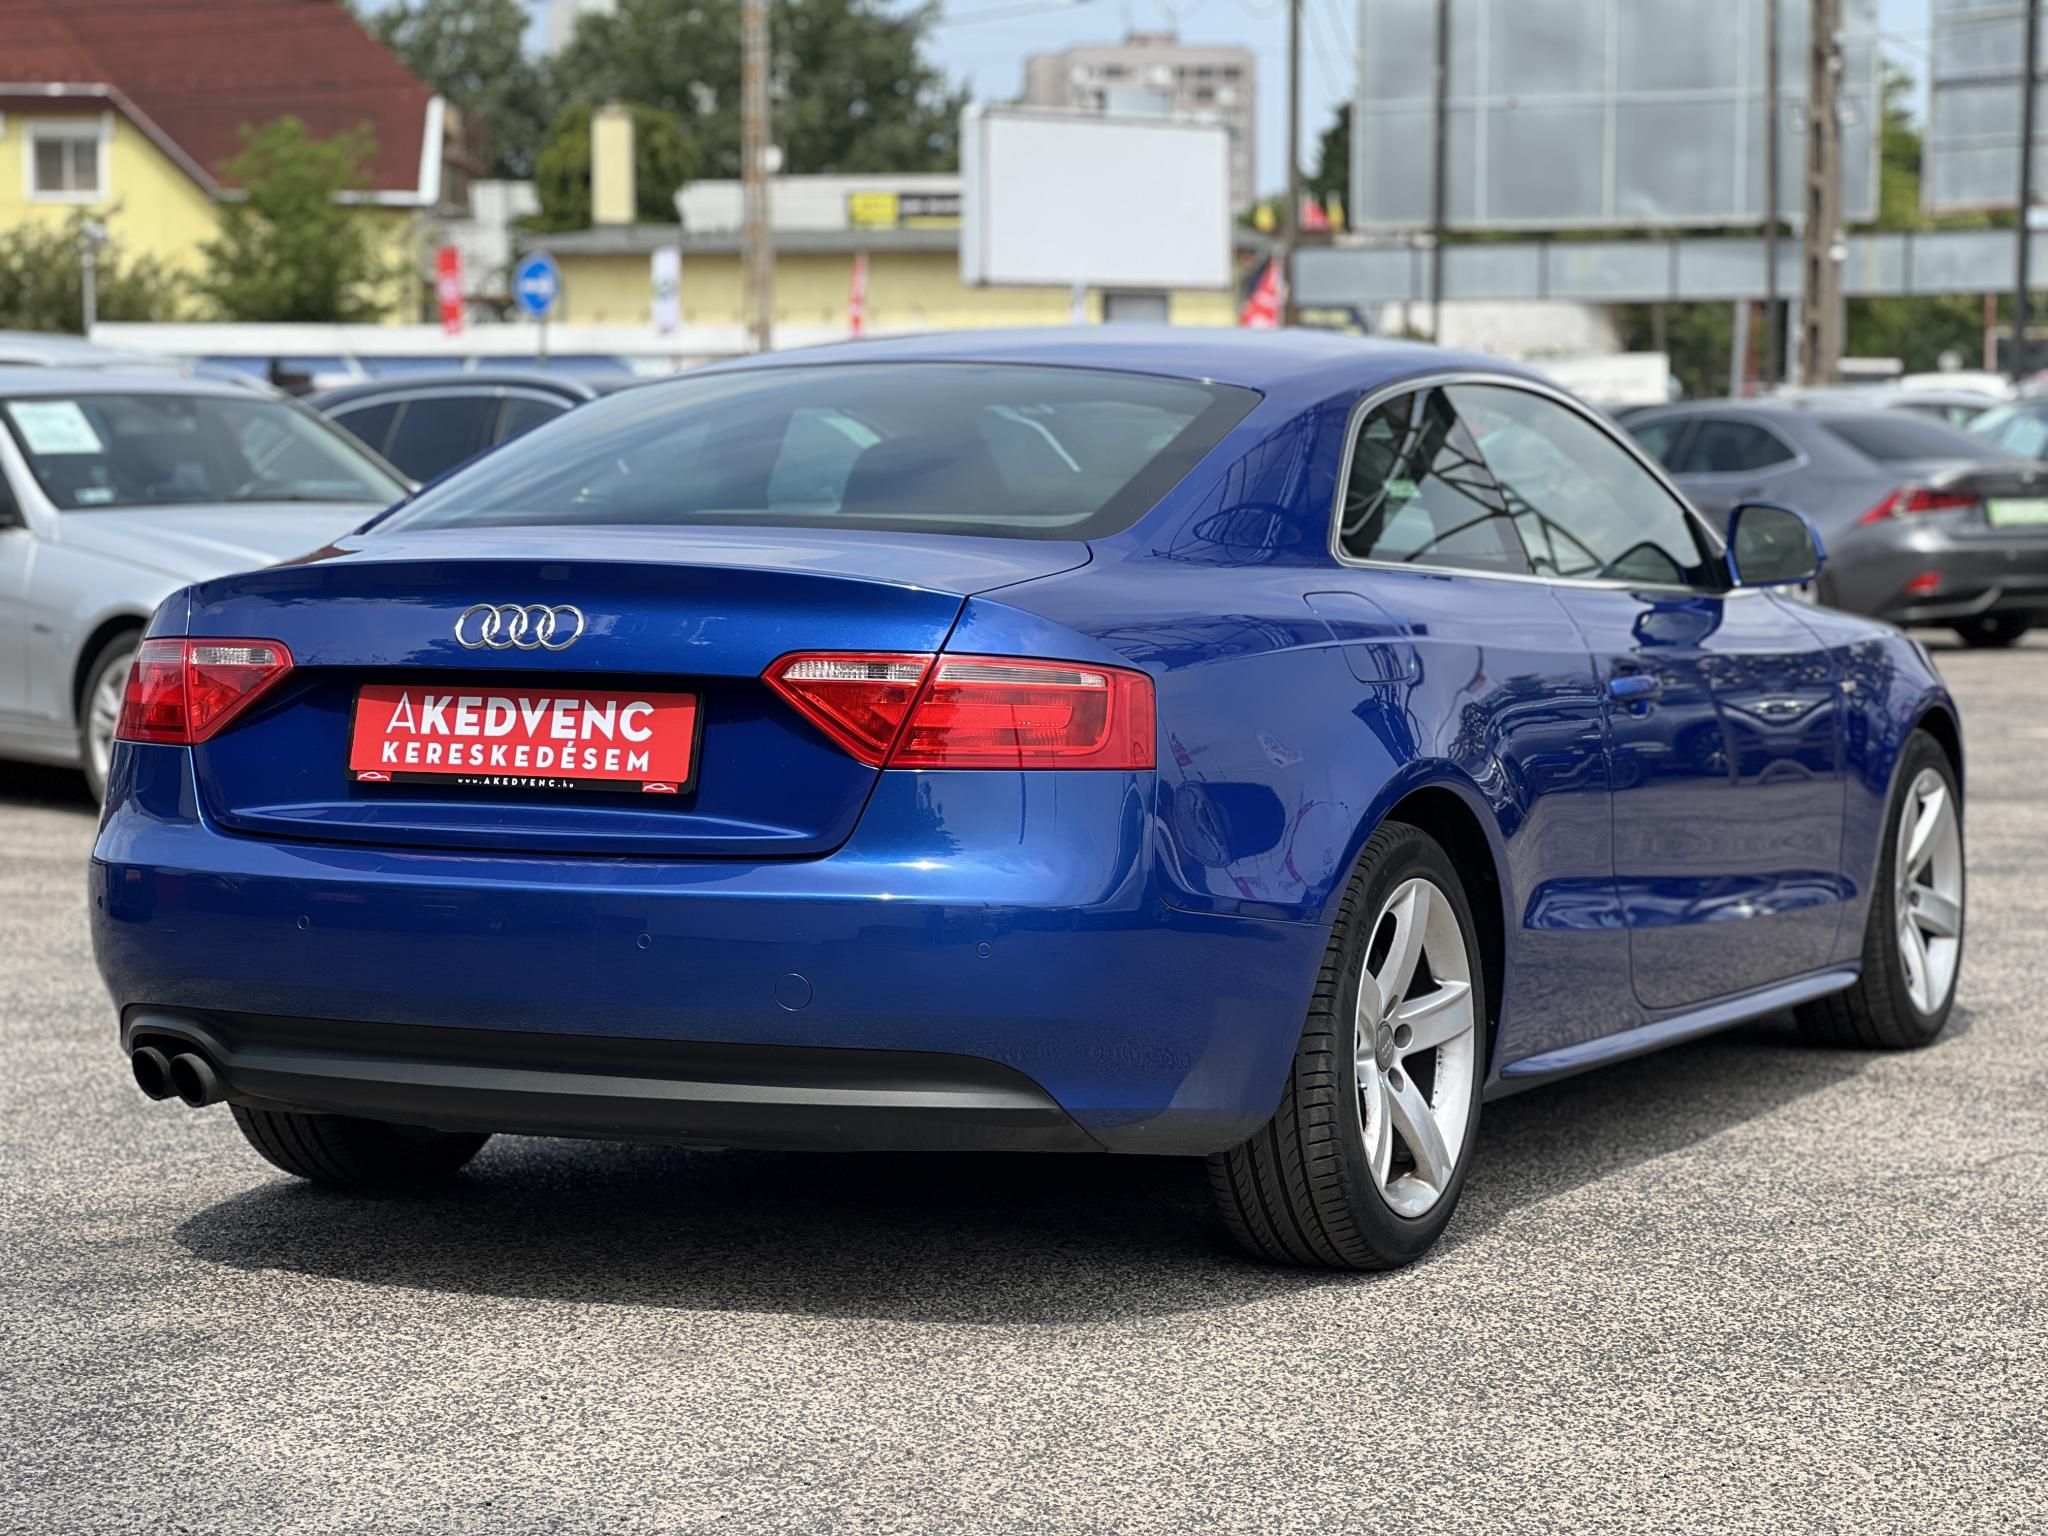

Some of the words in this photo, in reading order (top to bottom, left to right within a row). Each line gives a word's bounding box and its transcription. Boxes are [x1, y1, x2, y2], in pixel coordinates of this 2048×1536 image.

[386, 691, 654, 742] AKEDVENC
[381, 741, 650, 772] KERESKEDÉSEM
[457, 777, 574, 789] www.AKEDVENC.hu
